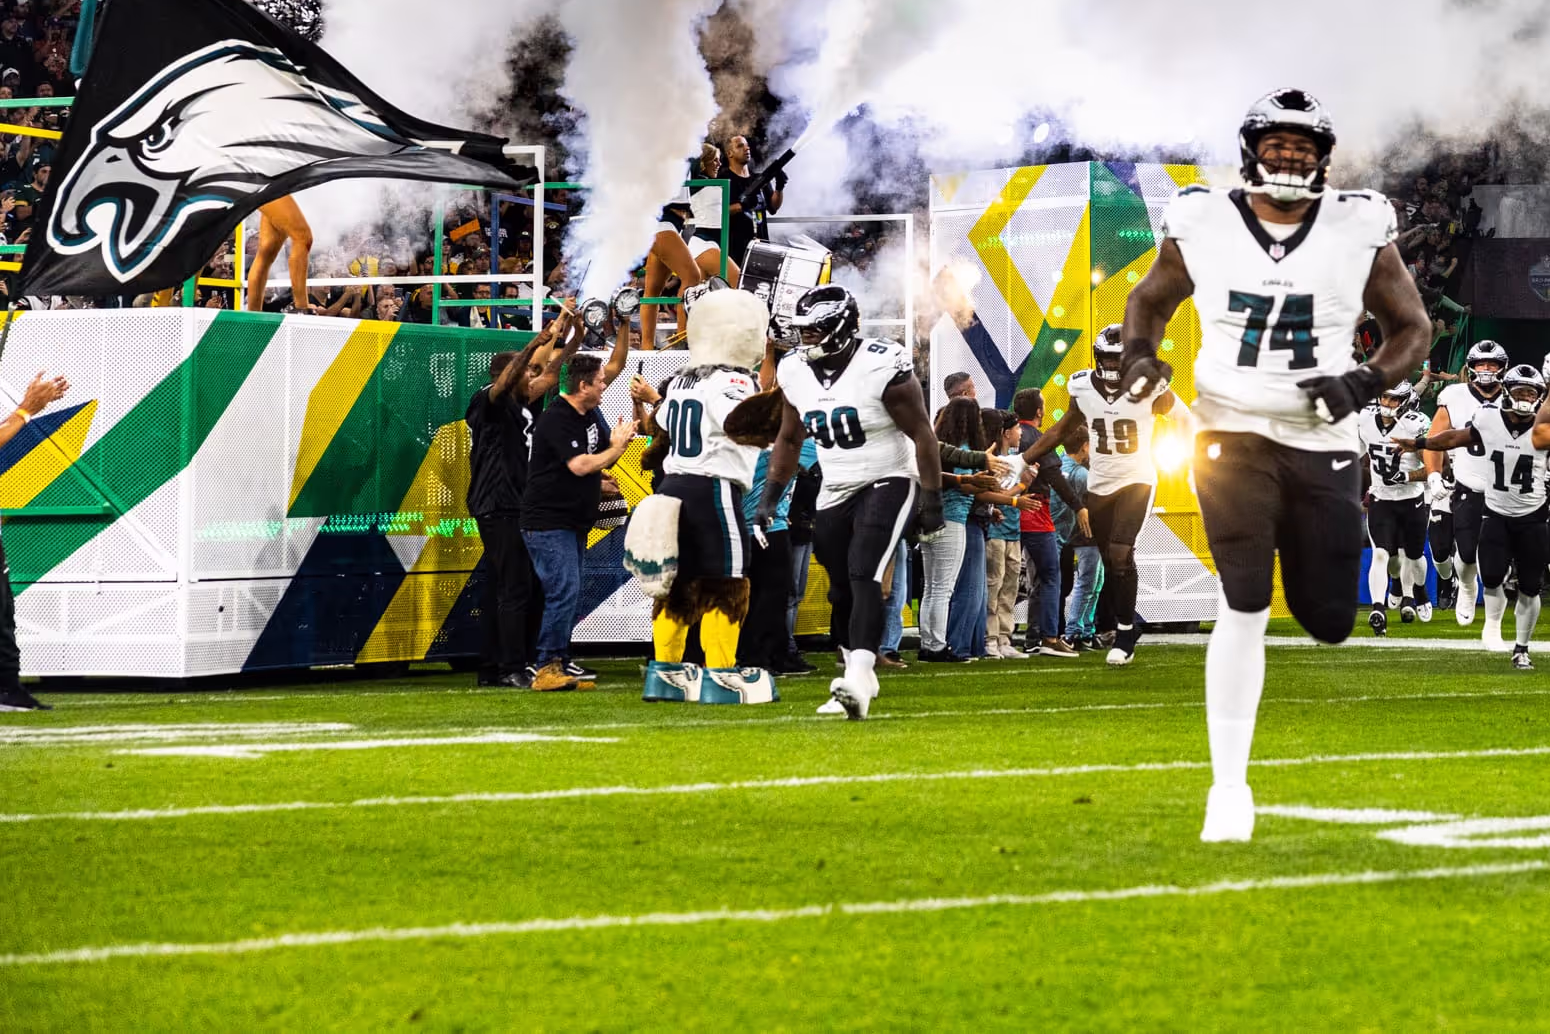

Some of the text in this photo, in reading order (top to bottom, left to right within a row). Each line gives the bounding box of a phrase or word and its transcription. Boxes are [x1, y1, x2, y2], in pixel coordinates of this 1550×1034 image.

[1228, 290, 1319, 370] 74
[1091, 418, 1139, 455] 19
[1490, 450, 1535, 494] 14
